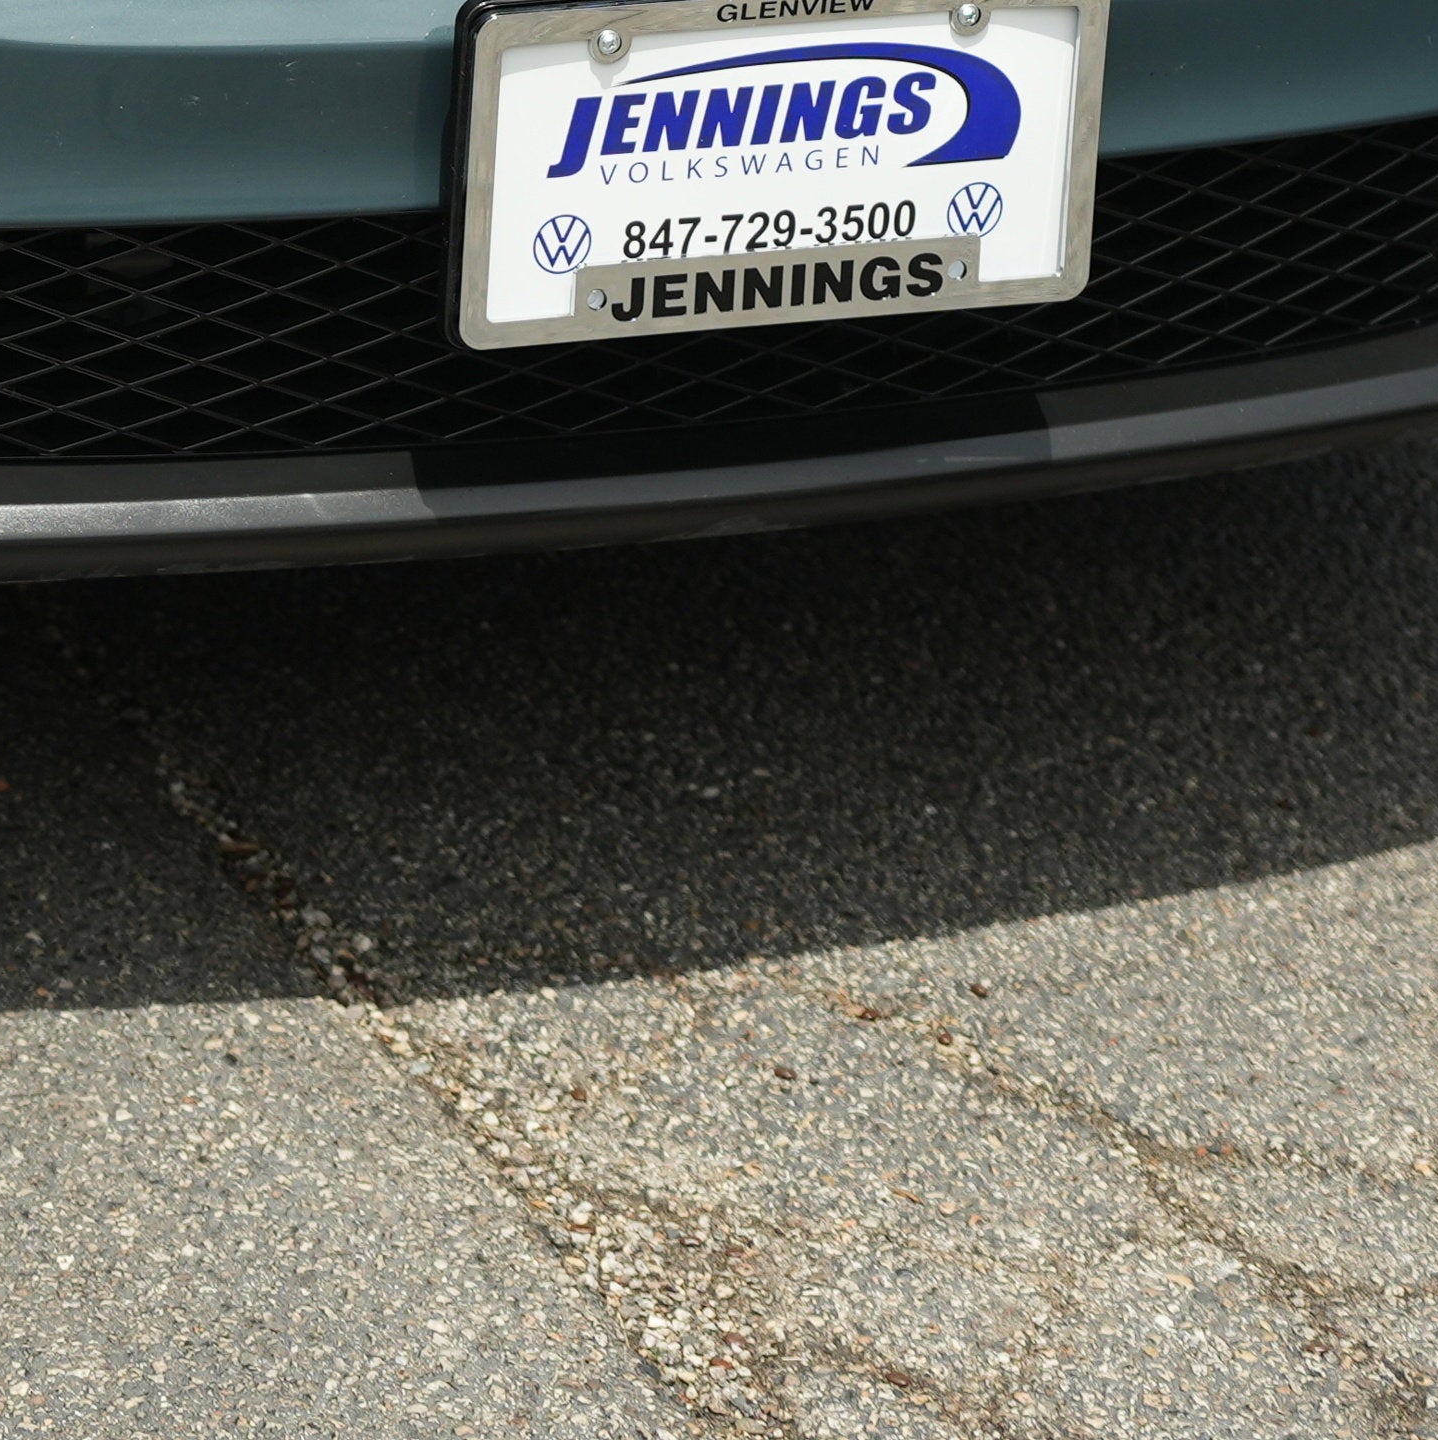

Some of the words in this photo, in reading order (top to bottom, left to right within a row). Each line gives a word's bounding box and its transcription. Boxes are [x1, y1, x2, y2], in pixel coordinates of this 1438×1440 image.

[547, 70, 937, 179] JENNINGS
[599, 144, 881, 186] VOLKSWAGEN
[622, 198, 917, 260] 847-729-3500
[611, 251, 945, 323] JENNINGS
